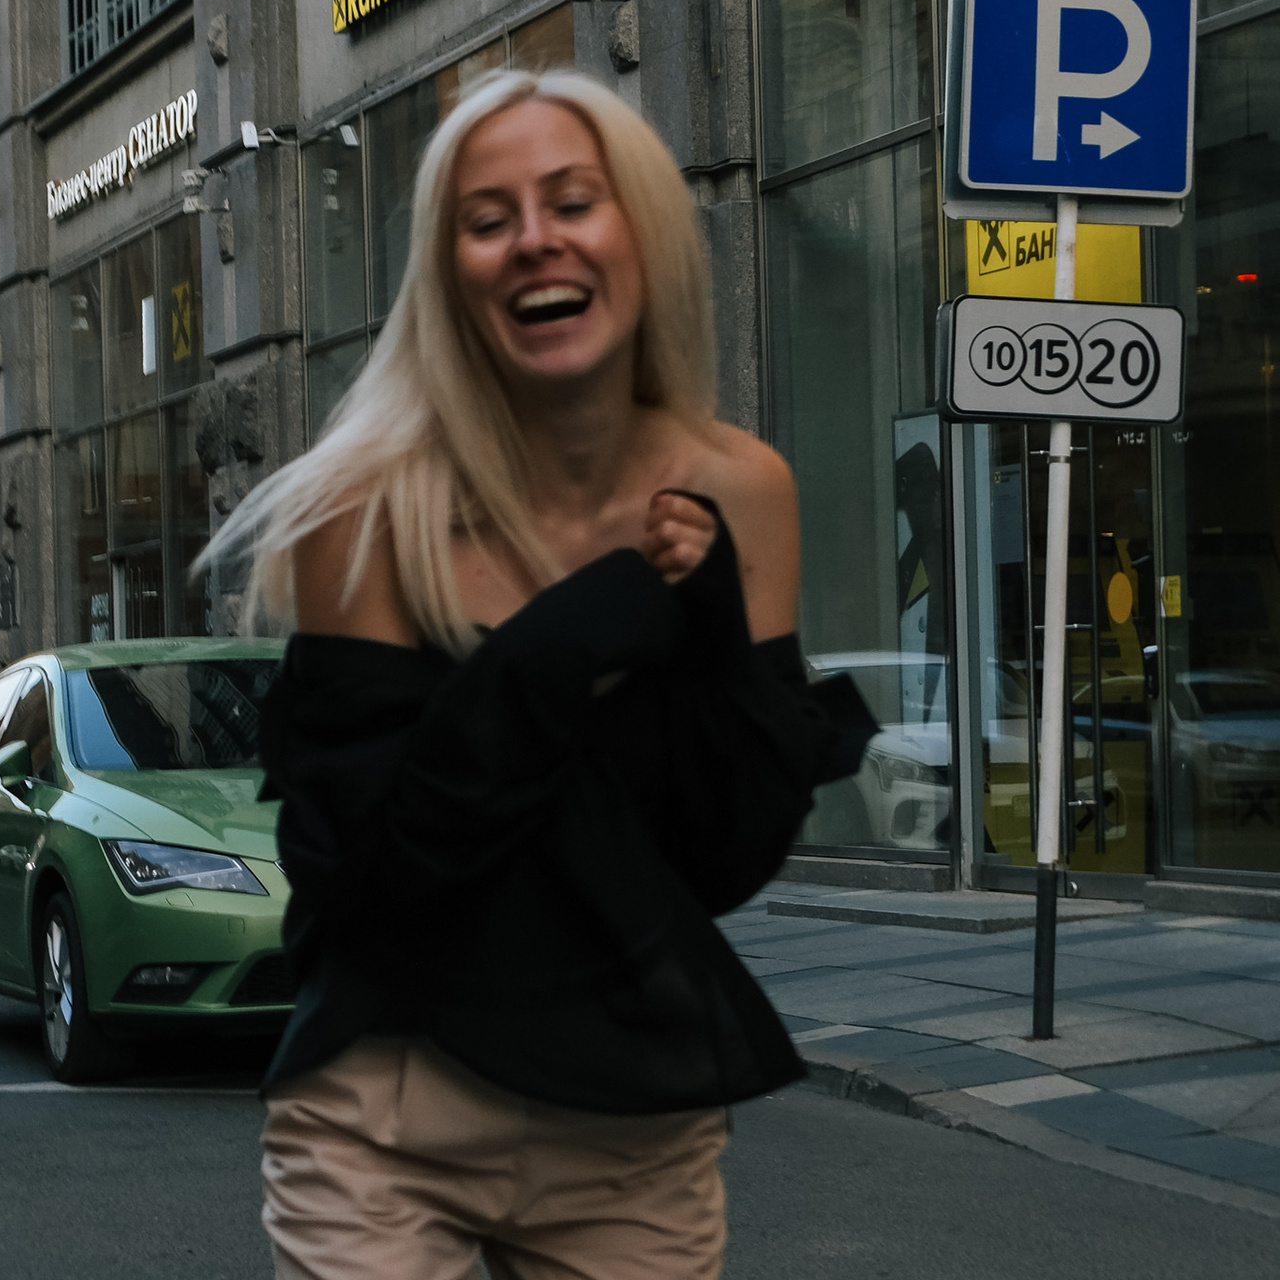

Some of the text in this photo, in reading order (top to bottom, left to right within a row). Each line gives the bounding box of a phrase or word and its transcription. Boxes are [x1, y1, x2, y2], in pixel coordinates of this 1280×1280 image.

[46, 88, 198, 220] Бизнес-центр СЕНАТОР
[1015, 226, 1058, 267] БАН
[982, 337, 1151, 387] 10 15 20
